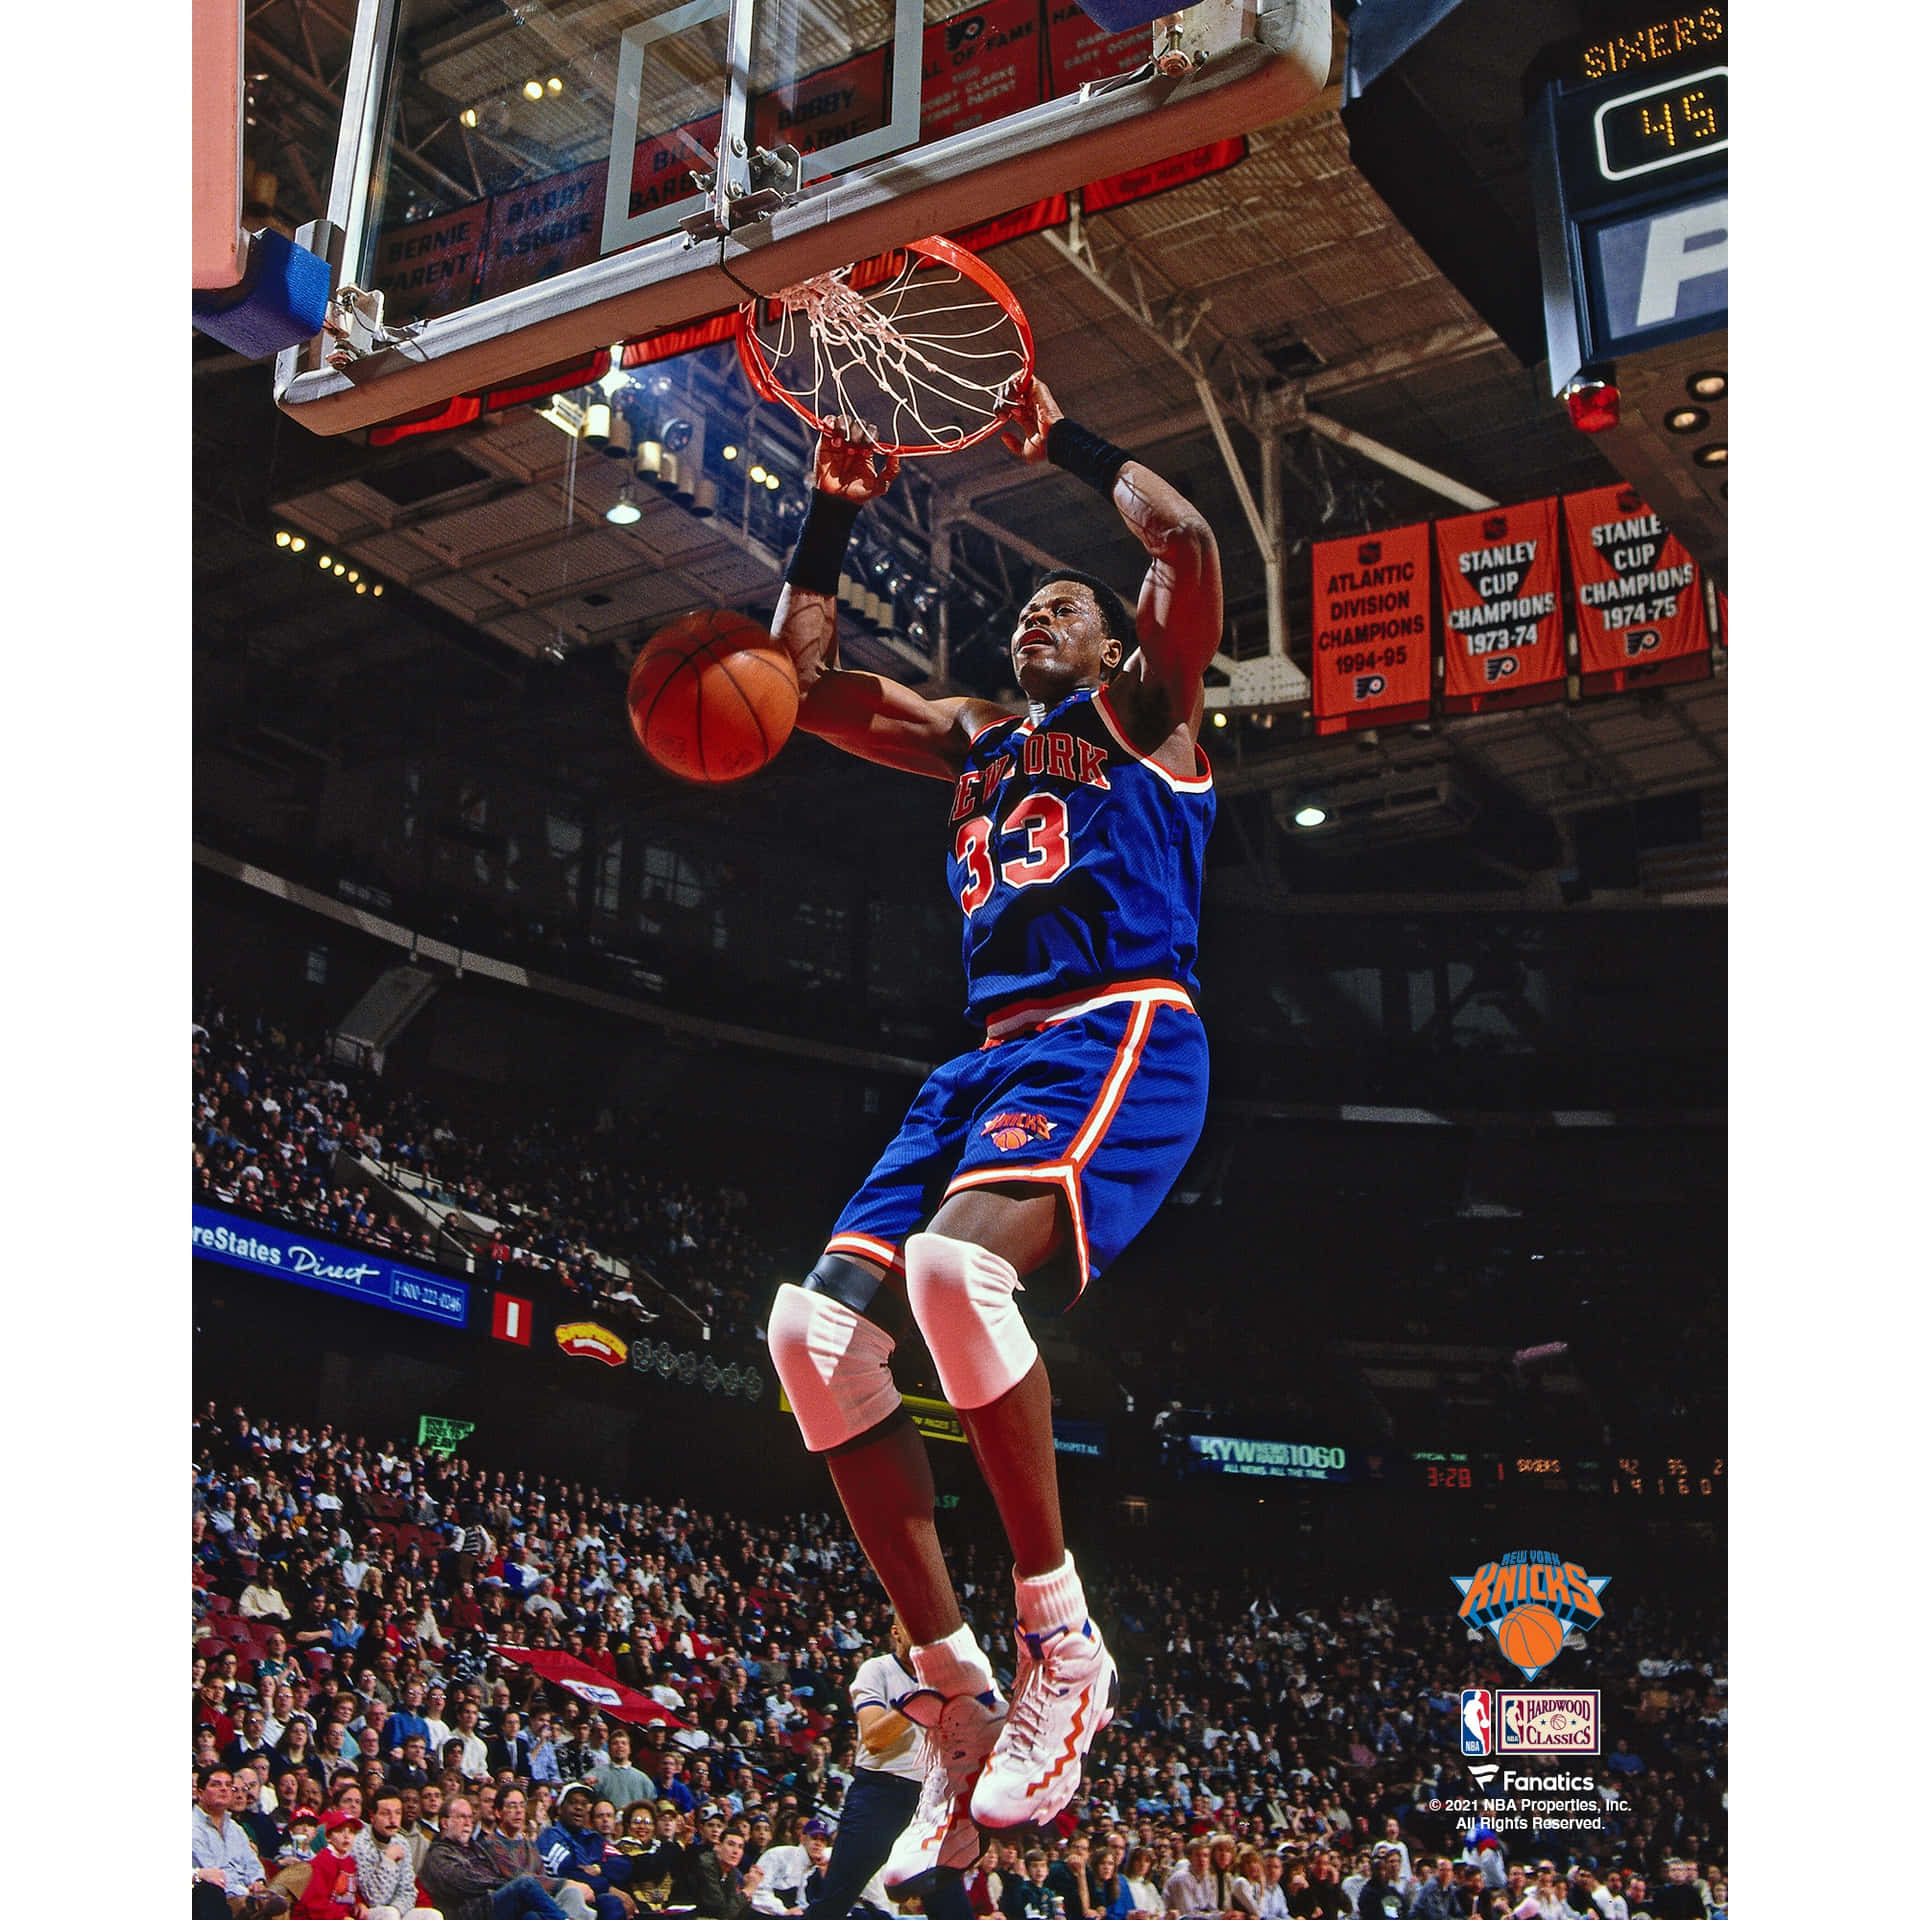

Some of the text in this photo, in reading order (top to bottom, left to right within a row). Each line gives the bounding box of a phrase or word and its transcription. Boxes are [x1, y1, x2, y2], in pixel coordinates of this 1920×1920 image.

[1584, 8, 1722, 78] SIXERS
[1641, 91, 1716, 146] 45
[388, 221, 472, 263] BERNIE
[1591, 513, 1664, 548] STANLE
[1458, 540, 1537, 574] STANLEY
[1613, 543, 1656, 571] CUP
[1328, 562, 1415, 595] ATLANTIC
[1479, 571, 1520, 598] CUP
[1580, 562, 1694, 605] CHAMPIONS
[1331, 590, 1410, 621] DIVISION
[1448, 592, 1556, 629] CHAMPIONS
[1603, 595, 1678, 630] 1974-75
[1319, 615, 1425, 651] CHAMPIONS
[1467, 624, 1537, 656] 1973-74
[1336, 646, 1407, 675] 1994-95
[949, 732, 1111, 828] EW ORK
[955, 792, 1070, 919] 33
[980, 1112, 1051, 1140] KNICKS
[192, 1225, 282, 1265] reStates
[288, 1246, 380, 1284] Direct
[1200, 1438, 1346, 1469] KYW 1060
